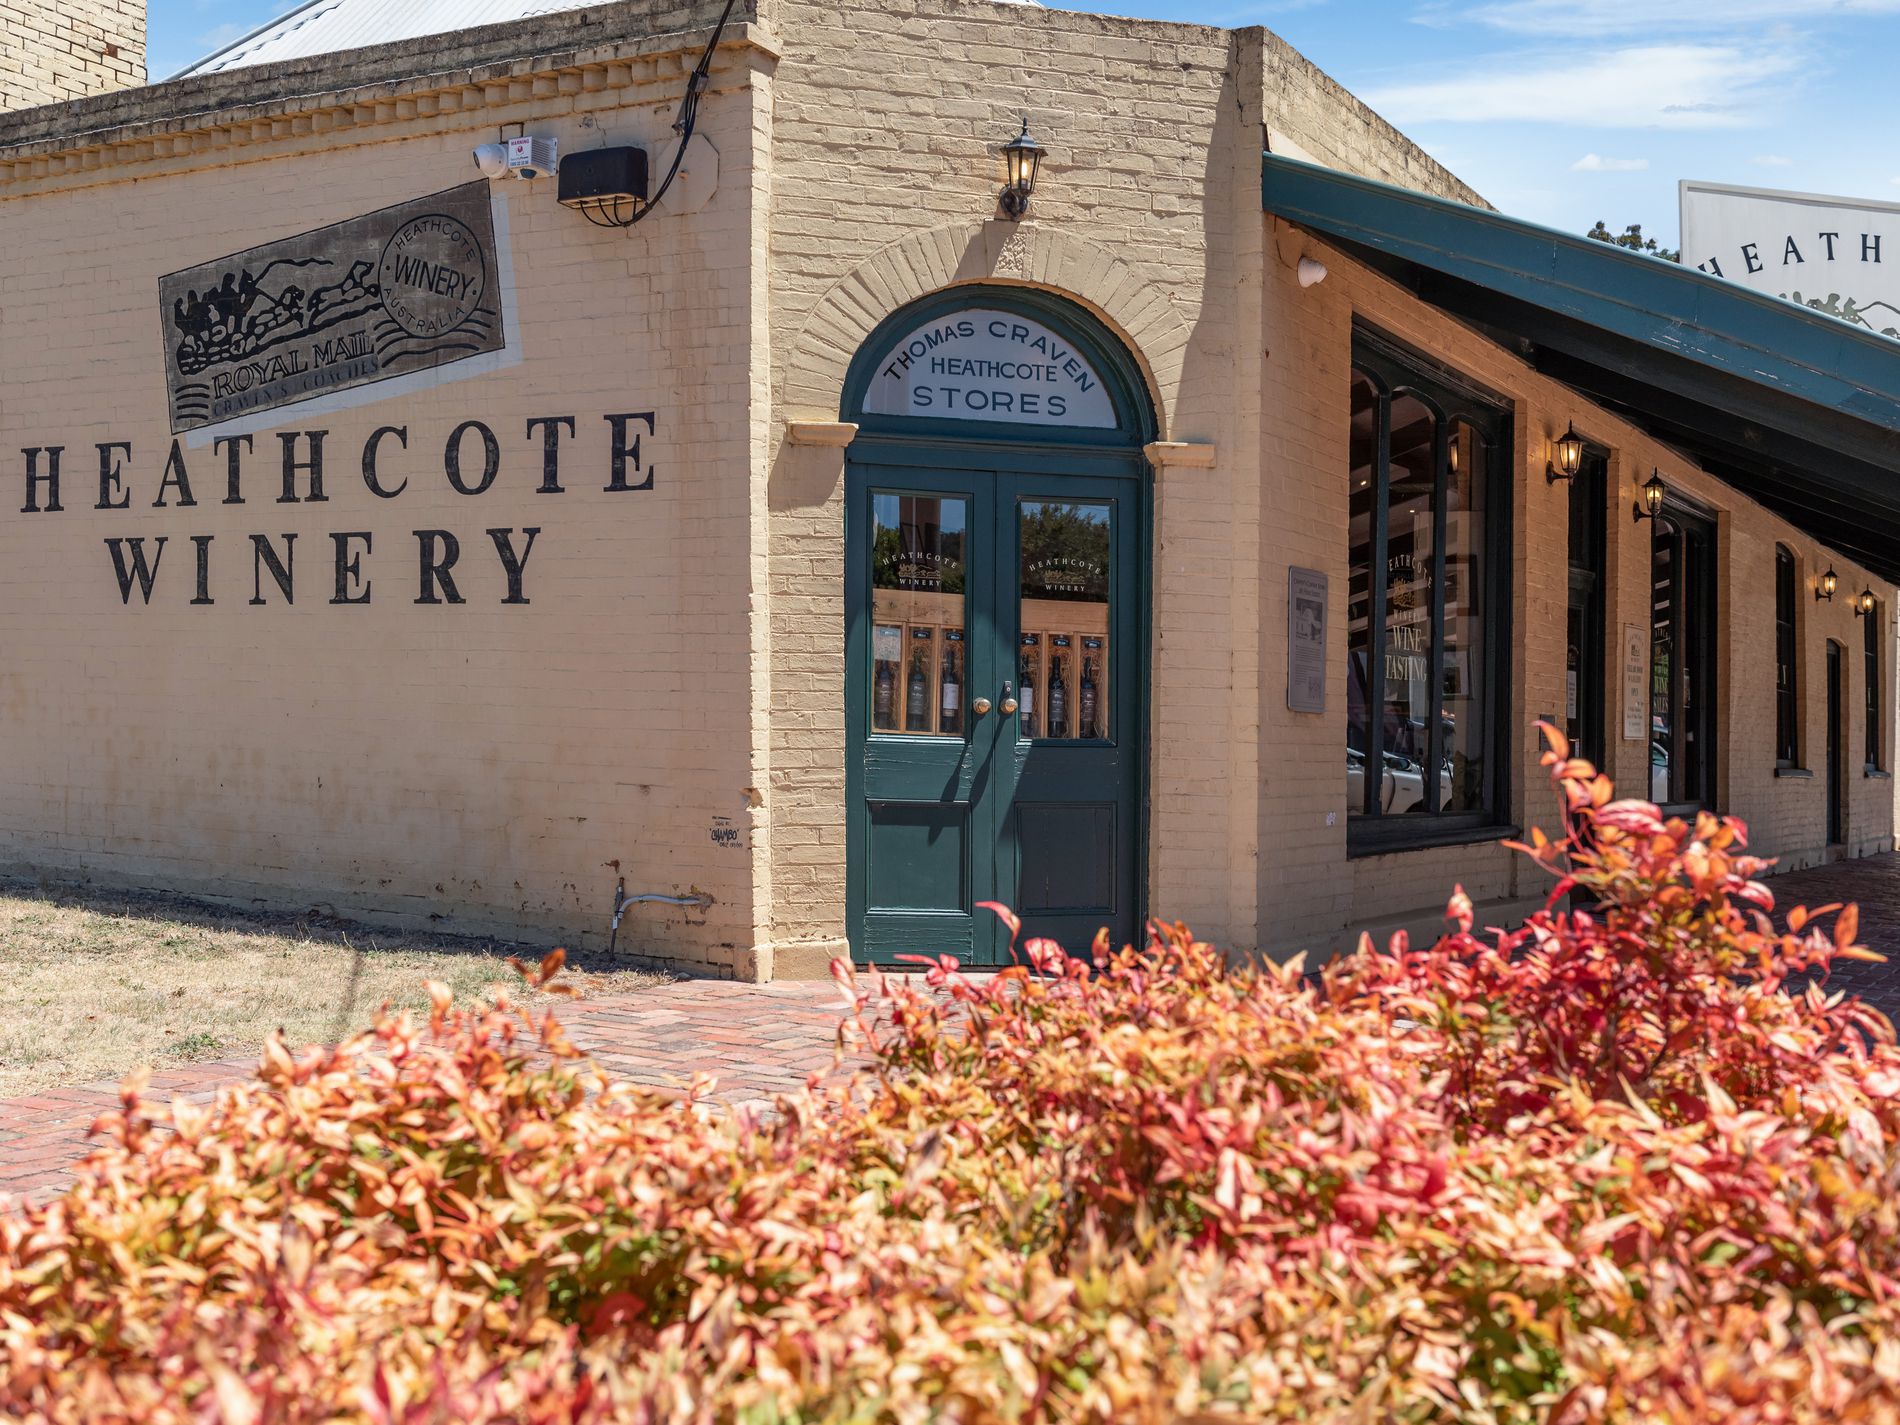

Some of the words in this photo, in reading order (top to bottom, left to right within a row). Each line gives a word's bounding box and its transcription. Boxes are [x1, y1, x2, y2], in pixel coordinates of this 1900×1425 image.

[395, 220, 476, 261] HEATHCOTE
[1697, 232, 1881, 278] HEATH
[395, 254, 475, 301] WINERY
[384, 288, 465, 332] AUSTRALIA
[212, 350, 308, 399] ROYAL
[312, 330, 374, 368] MAIL
[883, 321, 974, 381] THOMAS
[988, 321, 1095, 393] CRAVEN
[931, 357, 1057, 382] HEATHCOTE
[913, 386, 1067, 417] STORES
[20, 411, 655, 513] HEATHCOTE
[104, 527, 540, 605] WINERY
[882, 552, 958, 569] HEATHCOTE
[1029, 558, 1101, 574] HEATHCOTE
[1388, 554, 1433, 588] EATHCOTE
[900, 578, 940, 587] WINERY
[1045, 584, 1086, 592] WINERY
[1393, 625, 1421, 652] WINE
[1385, 655, 1427, 682] TASTING
